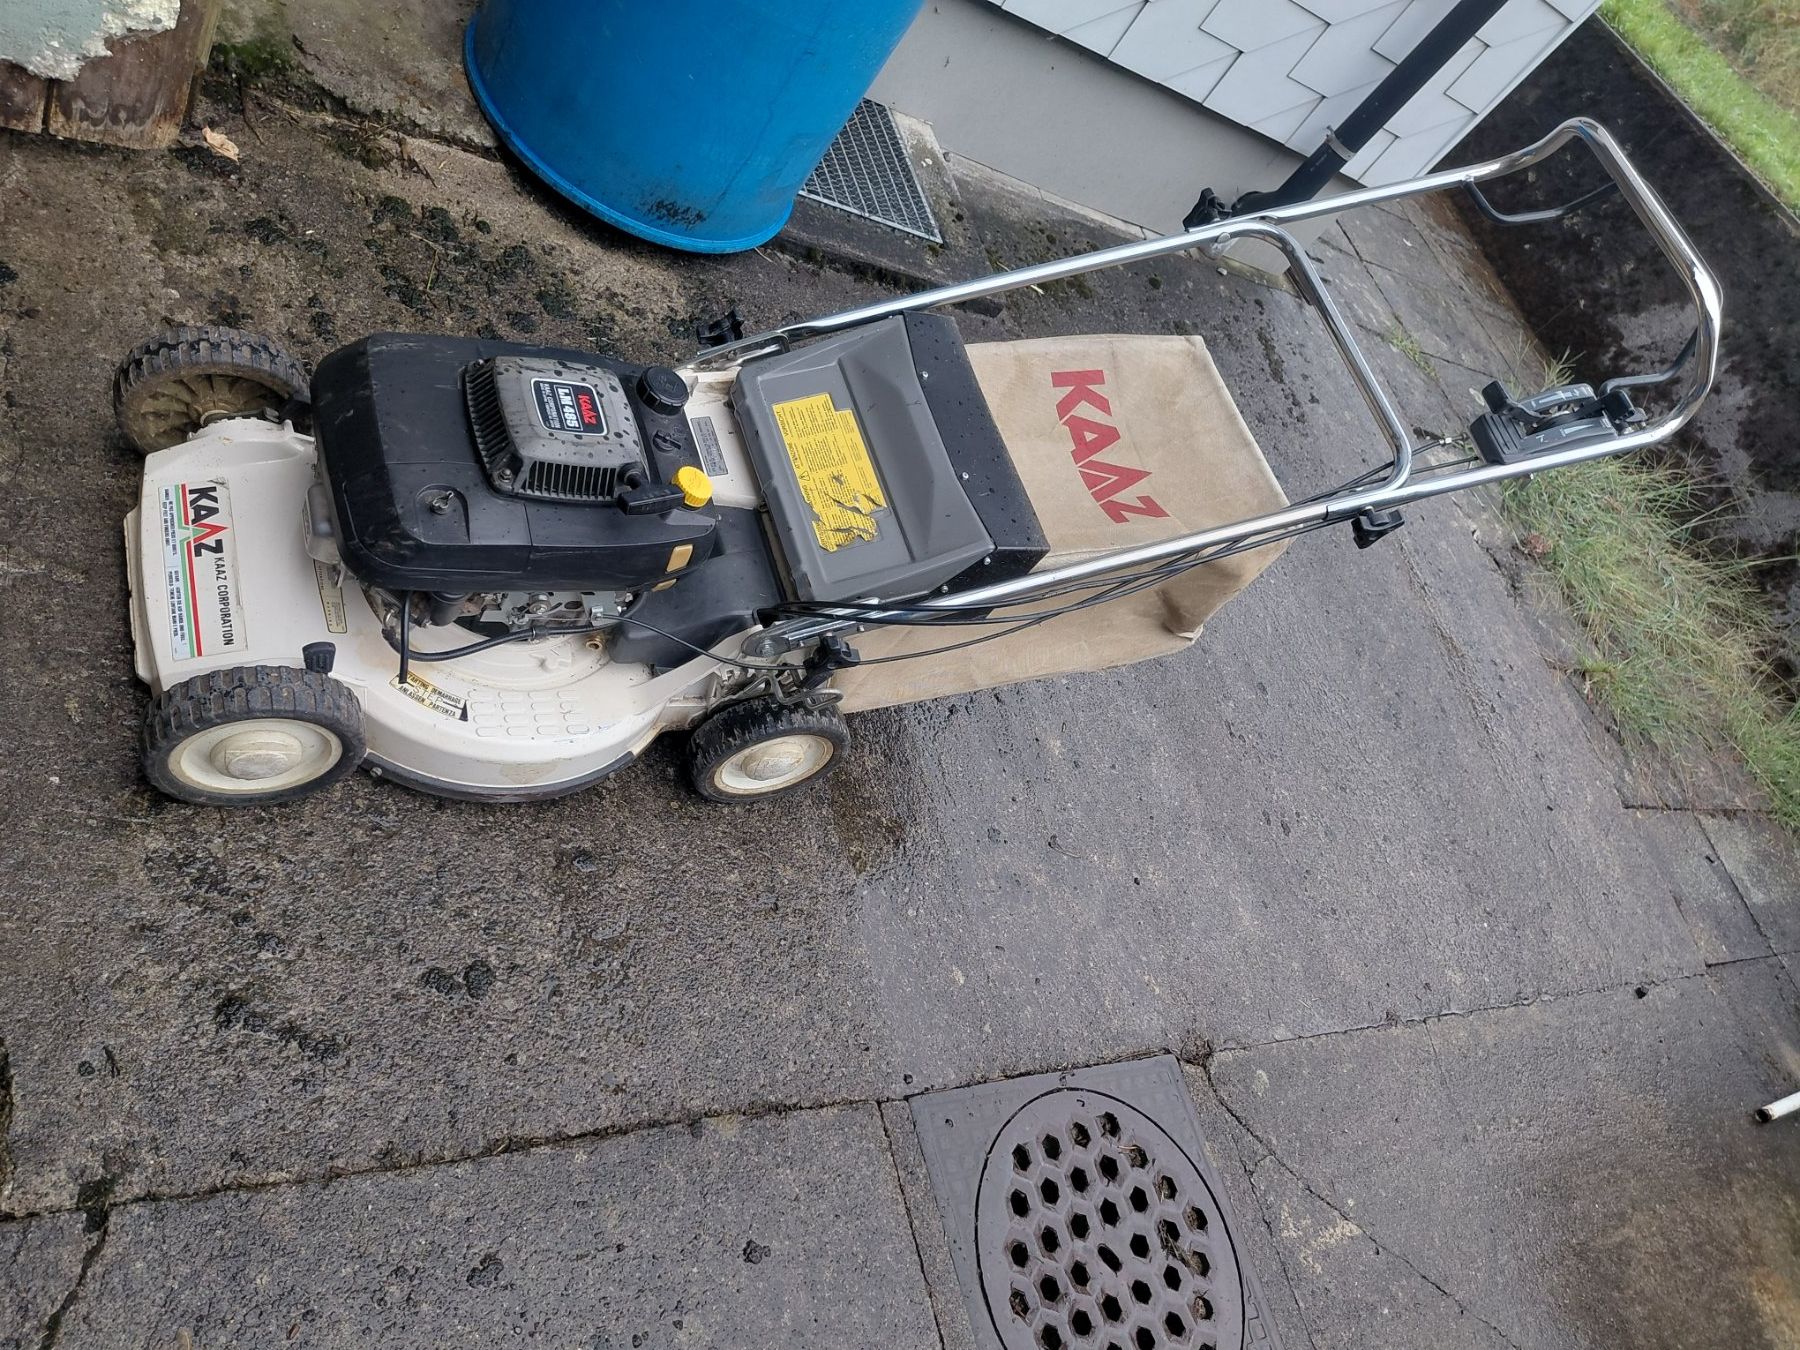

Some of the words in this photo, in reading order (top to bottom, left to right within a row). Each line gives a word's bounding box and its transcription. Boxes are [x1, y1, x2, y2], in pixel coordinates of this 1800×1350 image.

[578, 394, 597, 424] KAAZ
[1051, 370, 1170, 523] KAAZ
[188, 486, 229, 557] KAAZ
[213, 557, 227, 581] KAAZ
[217, 584, 234, 646] CORPORATION
